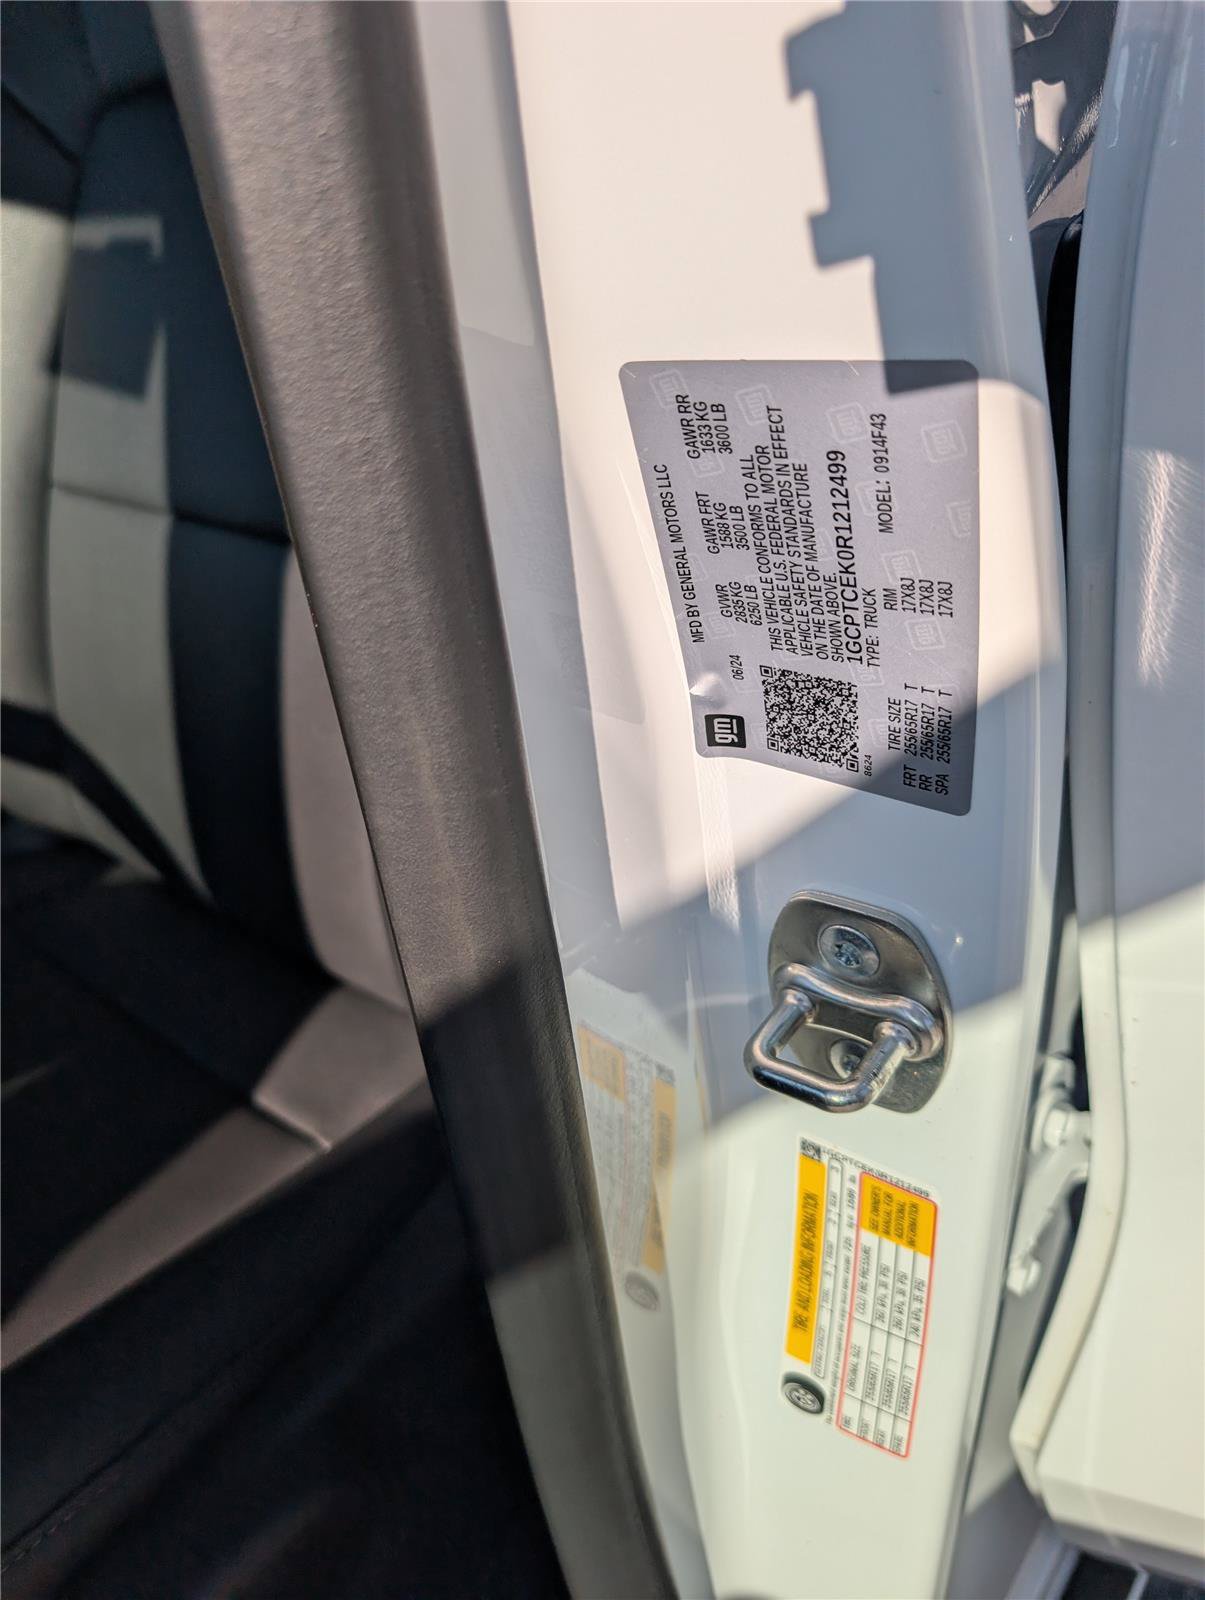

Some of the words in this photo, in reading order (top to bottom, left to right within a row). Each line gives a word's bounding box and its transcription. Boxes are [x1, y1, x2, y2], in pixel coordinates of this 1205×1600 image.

[676, 394, 692, 413] RR
[693, 401, 710, 422] KG
[710, 404, 726, 422] LB
[680, 418, 700, 459] GAWR
[698, 425, 715, 453] 1633
[714, 425, 732, 454] 3600
[766, 405, 788, 459] EFFECT
[870, 413, 890, 473] 0914F43
[654, 464, 671, 488] LLC
[740, 454, 756, 480] ALL
[755, 446, 774, 494] MOTOR
[775, 464, 790, 476] IN
[695, 491, 712, 514] FRT
[744, 484, 759, 500] TO
[660, 492, 683, 543] MOTORS
[713, 502, 728, 520] KG
[729, 506, 744, 521] LB
[778, 480, 801, 558] STANDARDS
[792, 463, 818, 562] MANUFACTURE
[876, 481, 894, 534] MODEL:
[701, 518, 719, 554] GAWR
[717, 523, 733, 548] 1588
[734, 524, 749, 550] 3500
[748, 505, 771, 573] CONFORMS
[764, 498, 785, 556] FEDERAL
[826, 450, 862, 664] 1GCPTCEK0R1212499
[673, 546, 695, 600] GENERAL
[774, 560, 788, 581] U.S.
[806, 565, 820, 581] OF
[728, 582, 743, 598] KG
[744, 585, 758, 600] LB
[789, 561, 807, 607] SAFETY
[823, 573, 840, 617] ABOVE.
[900, 577, 916, 613] 17X8J
[685, 604, 699, 617] BY
[715, 584, 732, 617] GVWR
[732, 599, 748, 623] 2835
[760, 576, 778, 624] VEHICLE
[808, 584, 824, 615] DATE
[862, 588, 878, 628] TRUCK
[883, 588, 898, 611] RIM
[919, 580, 934, 616] 17X8J
[937, 581, 953, 618] 17X8J
[747, 602, 762, 625] 6250
[776, 584, 798, 654] APPLICABLE
[686, 621, 704, 643] MFD
[768, 628, 783, 651] THIS
[796, 610, 813, 656] VEHICLE
[812, 618, 826, 640] THE
[828, 620, 844, 662] SHOWN
[815, 643, 828, 660] ON
[866, 636, 880, 667] TYPE:
[729, 655, 744, 680] 06/24
[921, 686, 934, 694] T
[888, 697, 900, 723] SIZE
[714, 718, 738, 744] gm
[888, 725, 900, 750] TIRE
[904, 700, 918, 756] 255/65R17
[921, 703, 934, 760] 255/65R17
[937, 706, 951, 764] 255/65R17
[864, 754, 872, 776] 8624
[903, 764, 916, 787] FRT
[918, 775, 932, 791] RR
[935, 775, 949, 795] SPA
